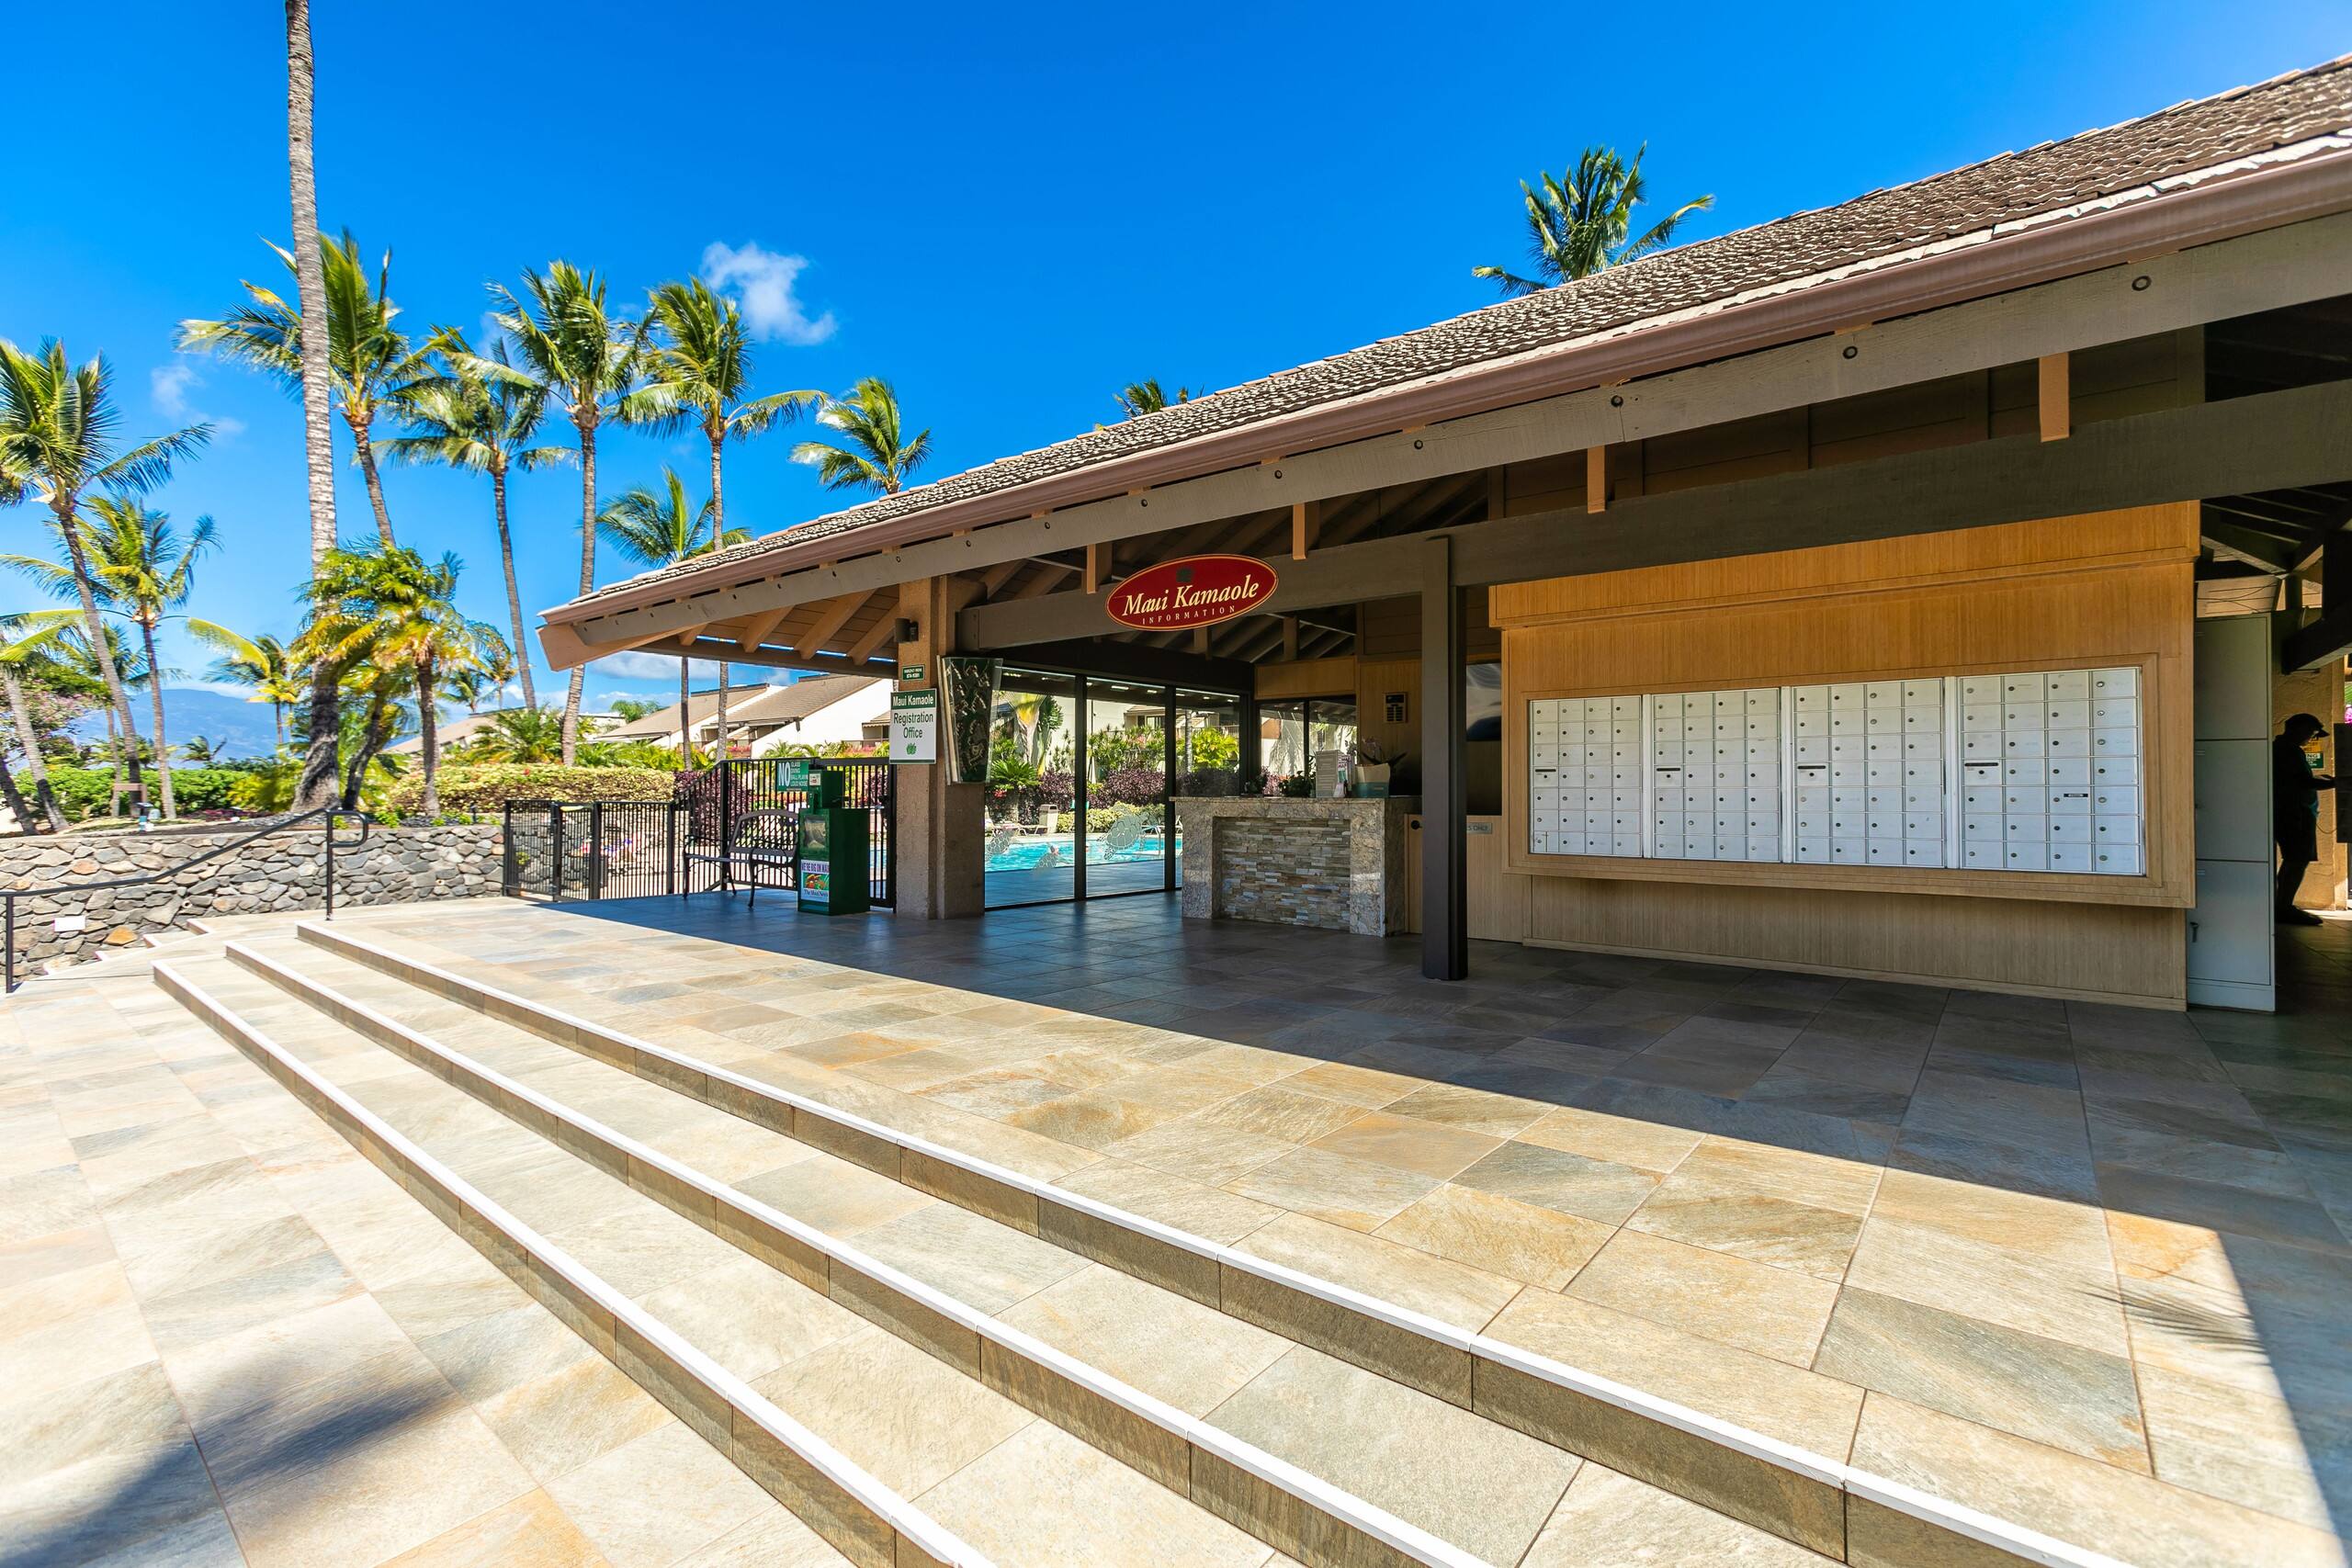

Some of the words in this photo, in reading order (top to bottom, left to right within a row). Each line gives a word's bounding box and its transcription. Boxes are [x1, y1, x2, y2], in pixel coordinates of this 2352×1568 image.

[1122, 590, 1170, 616] Maui
[1172, 574, 1260, 609] Kamaole
[1142, 604, 1236, 626] INFORMATION
[892, 695, 907, 706] Maui
[908, 694, 934, 705] Kamaole
[893, 712, 934, 727] Registration
[903, 727, 923, 739] Office
[778, 761, 790, 787] NO
